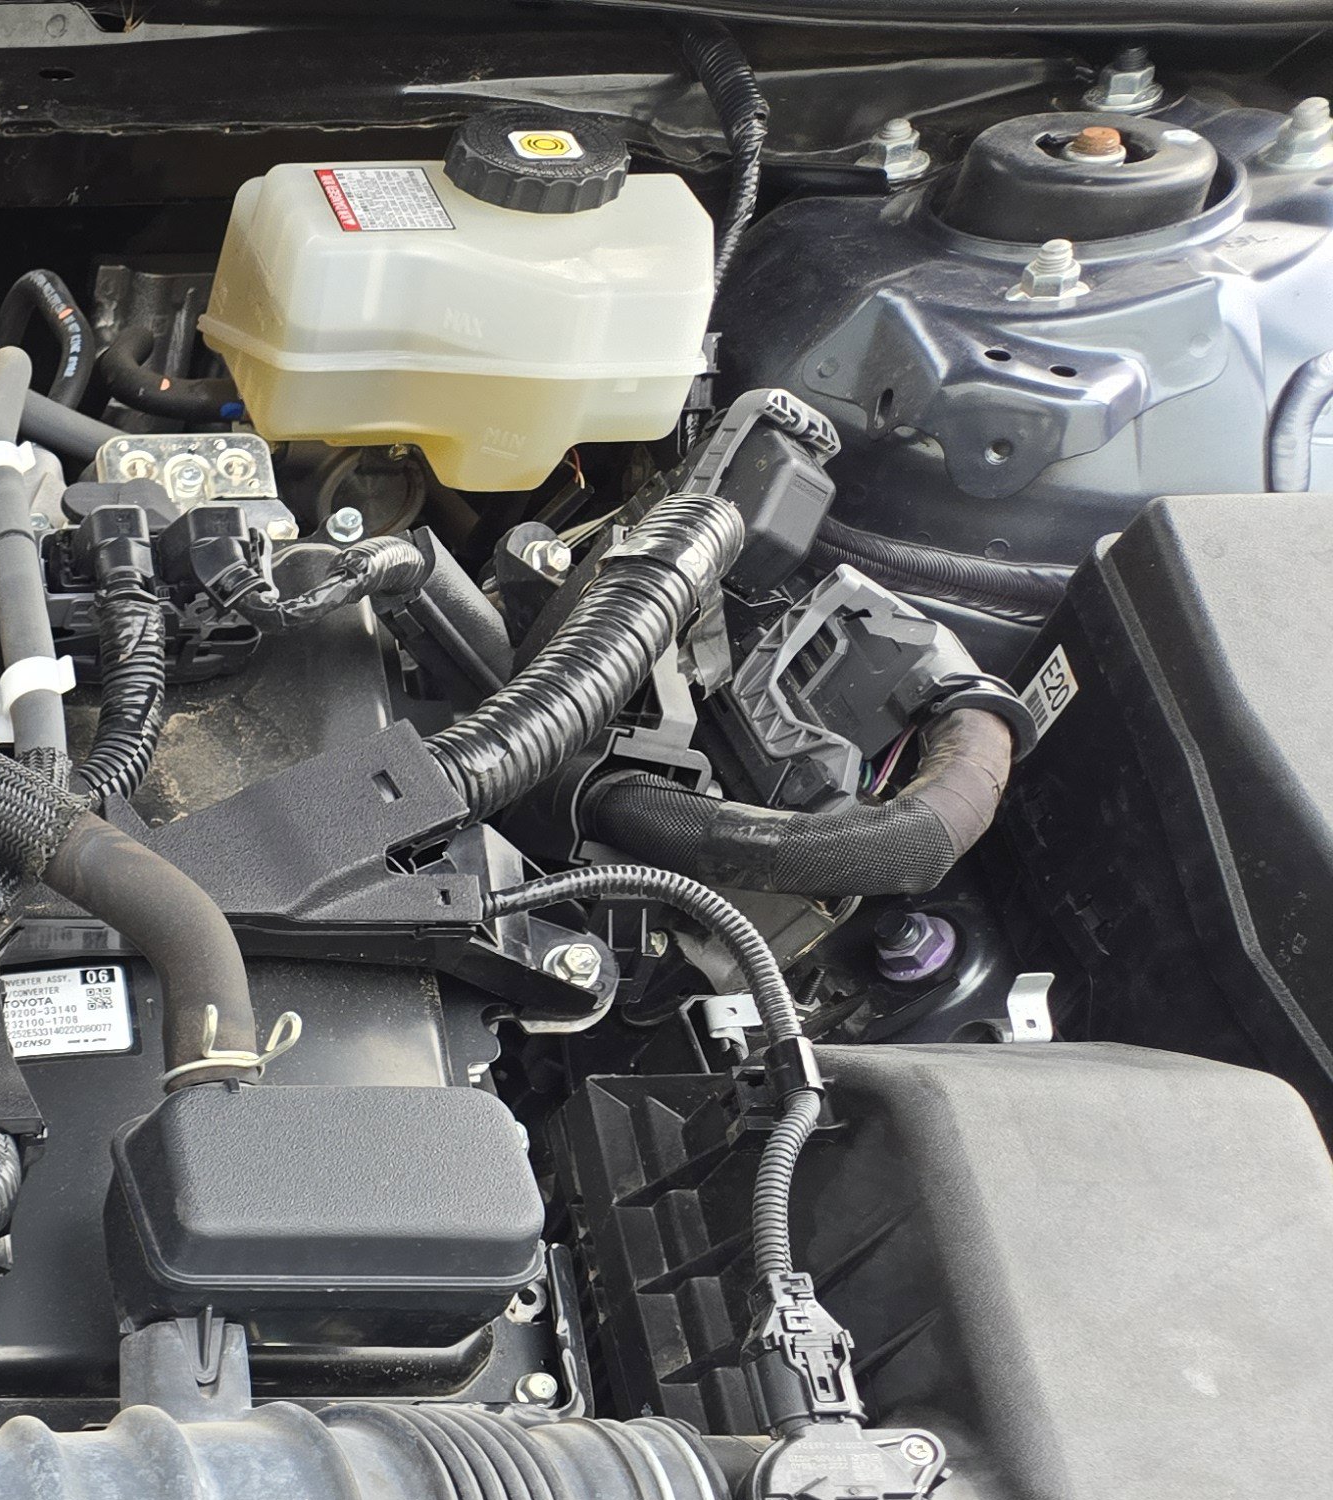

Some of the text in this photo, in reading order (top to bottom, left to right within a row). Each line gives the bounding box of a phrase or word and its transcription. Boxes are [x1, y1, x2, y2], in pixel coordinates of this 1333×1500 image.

[1040, 656, 1069, 711] E20
[4, 975, 72, 987] NVERTER ASSY.
[86, 969, 109, 984] 06
[5, 987, 60, 998] /CONVERTER
[4, 997, 53, 1009] TOYOTA
[15, 1039, 51, 1048] DENSO
